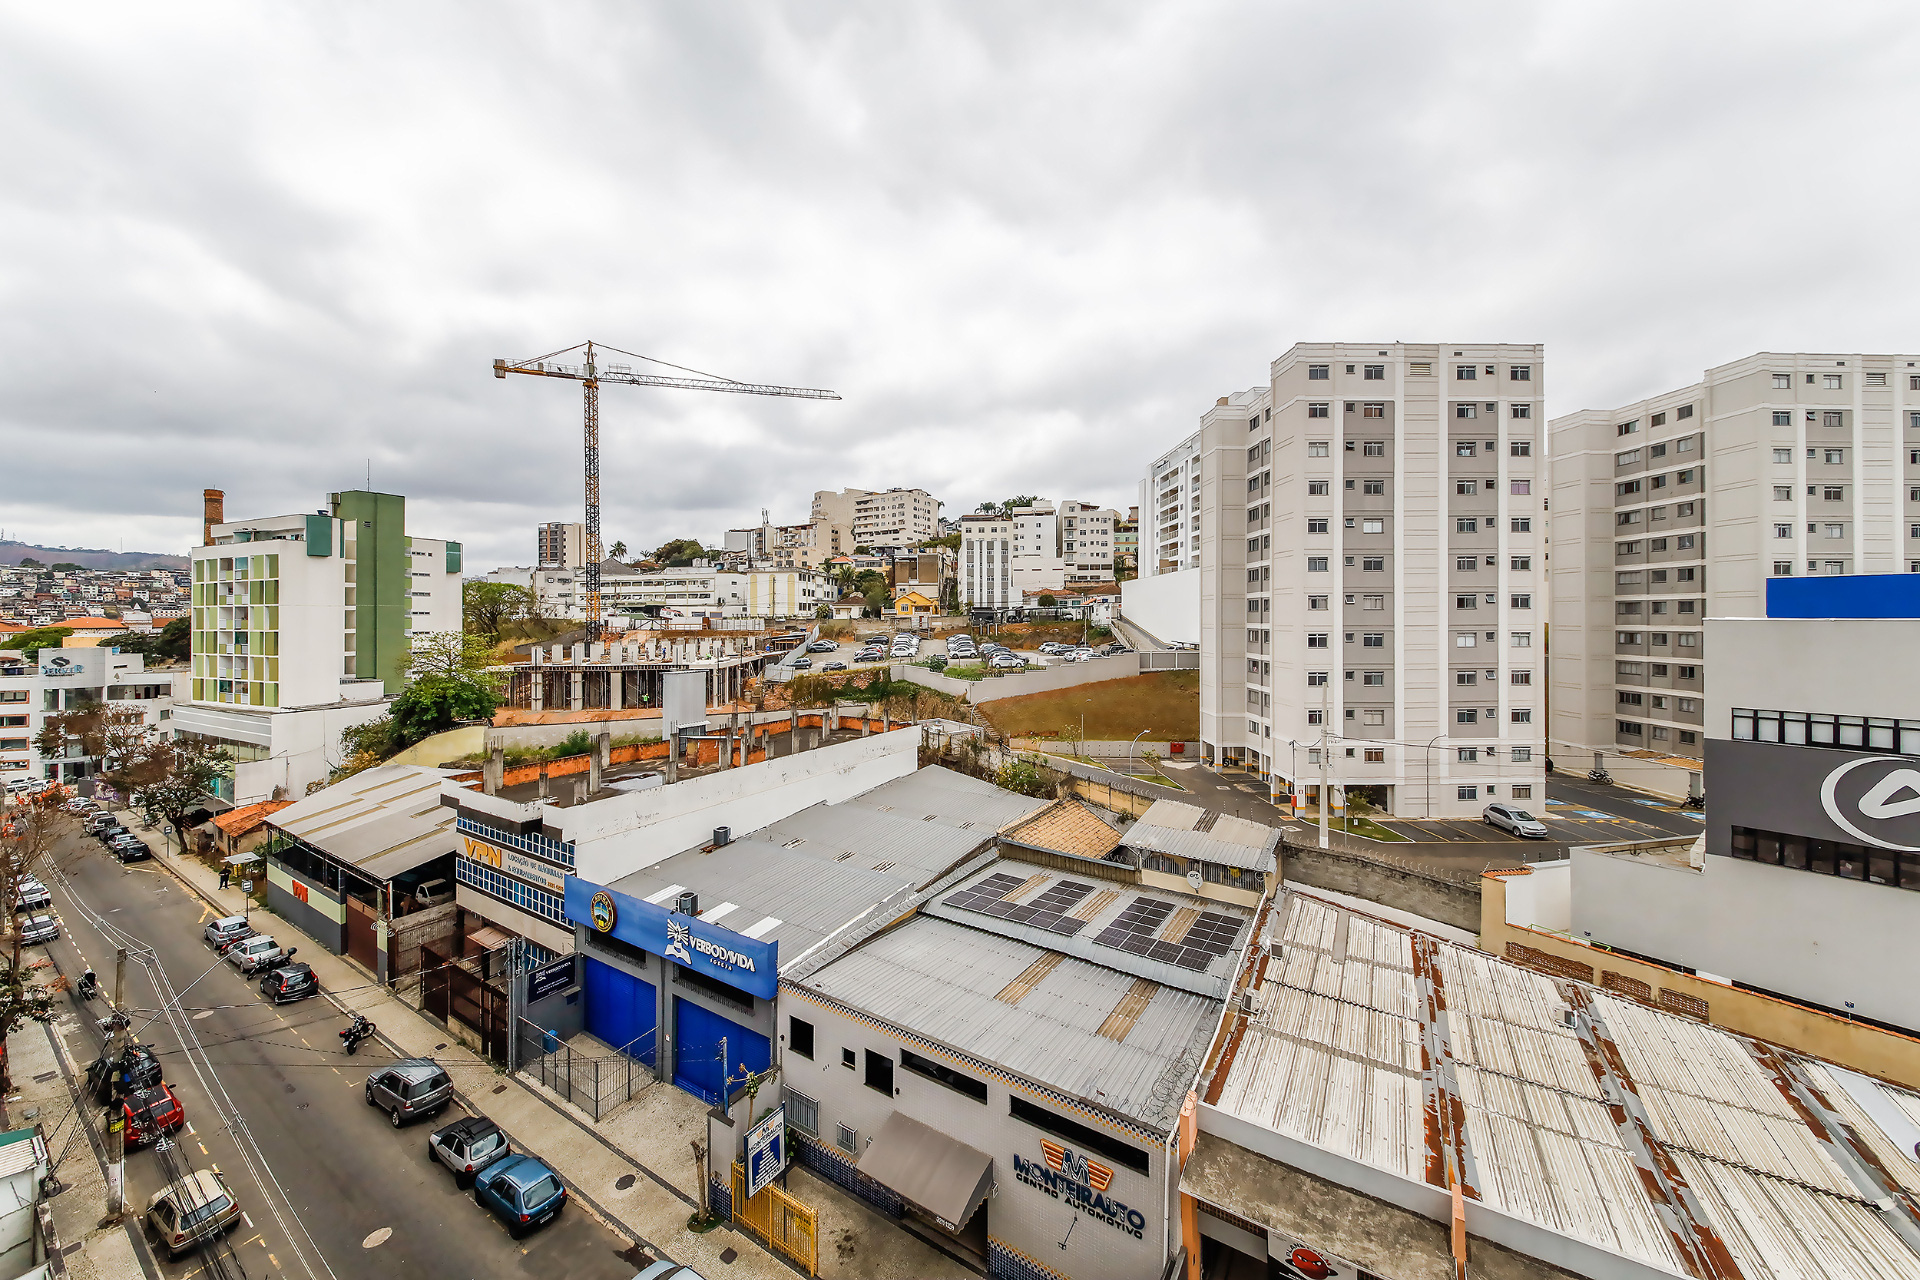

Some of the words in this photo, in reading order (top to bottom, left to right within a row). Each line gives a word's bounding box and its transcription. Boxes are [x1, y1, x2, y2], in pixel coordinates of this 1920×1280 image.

[463, 837, 502, 868] VPN
[1013, 1153, 1146, 1231] MONTEIRAUTO
[1016, 1172, 1059, 1200] CENTRO
[1064, 1198, 1143, 1240] AUTOMOTIVO
